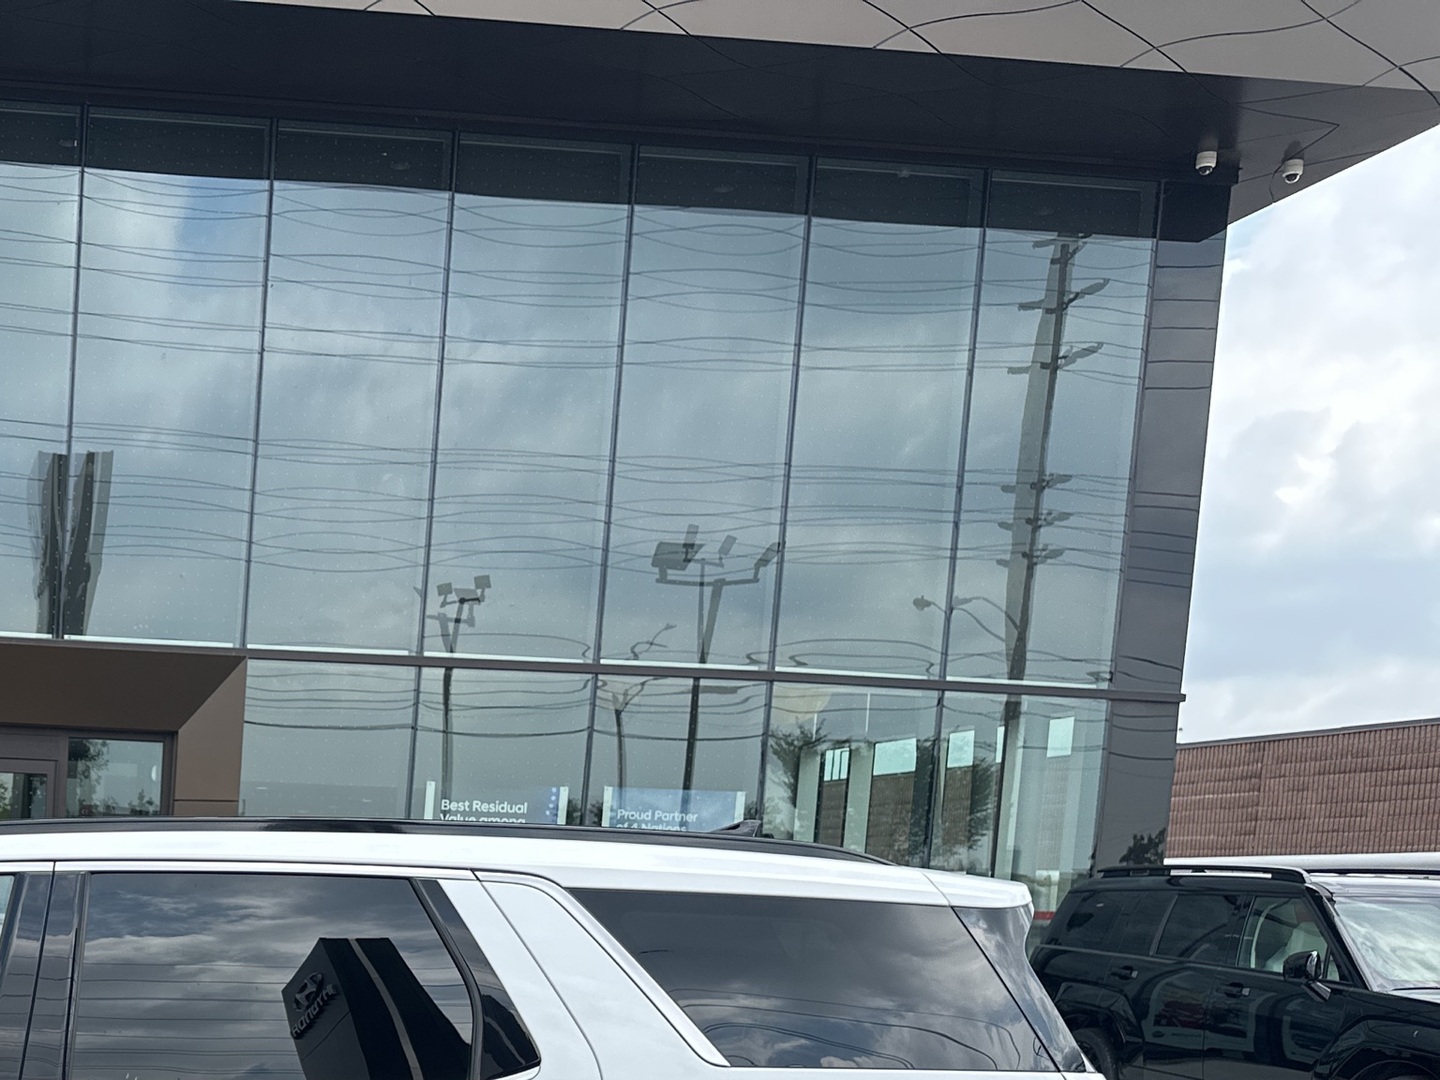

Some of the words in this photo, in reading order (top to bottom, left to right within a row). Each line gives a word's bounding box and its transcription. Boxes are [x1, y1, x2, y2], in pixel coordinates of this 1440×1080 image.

[441, 799, 470, 811] Best
[472, 800, 528, 813] Residual
[617, 809, 652, 820] Proud
[654, 810, 698, 822] Partner
